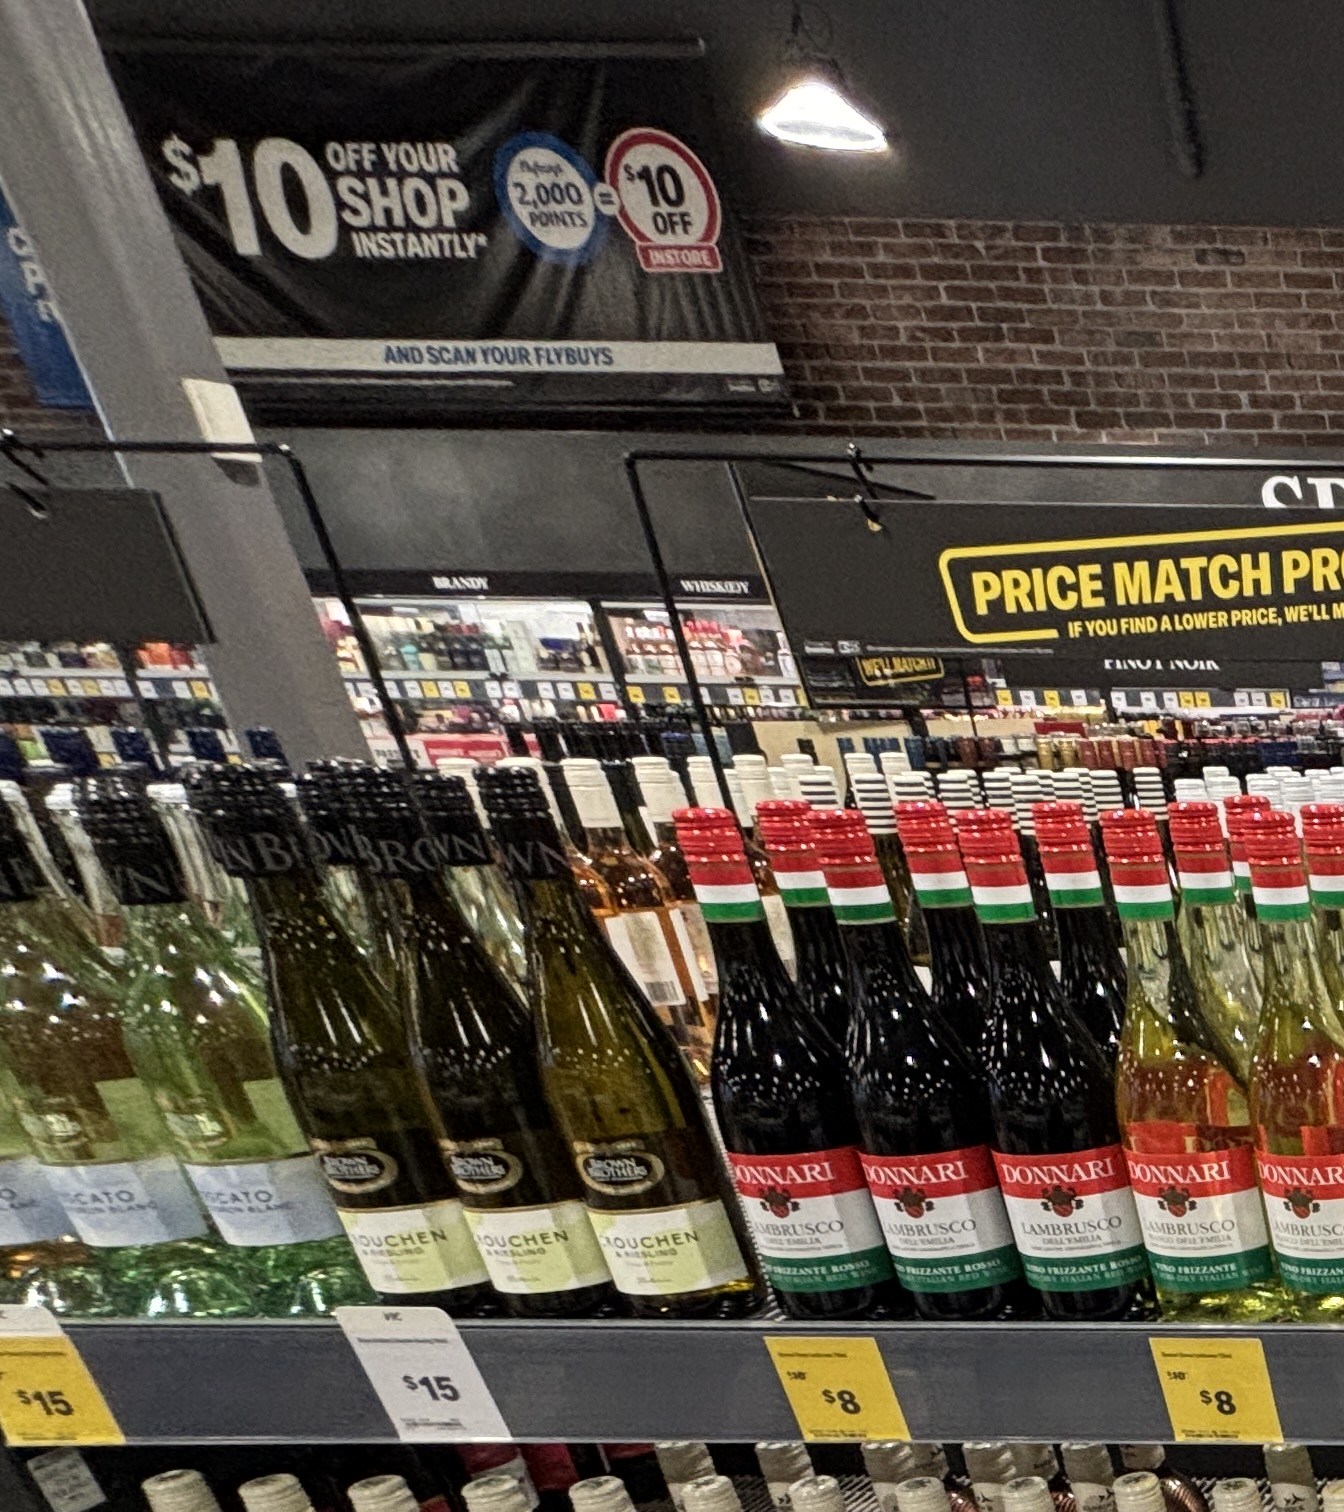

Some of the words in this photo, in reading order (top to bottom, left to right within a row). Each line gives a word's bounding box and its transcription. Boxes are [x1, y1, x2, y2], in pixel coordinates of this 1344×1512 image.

[327, 142, 377, 172] OFF
[383, 142, 460, 175] YOUR
[162, 133, 338, 260] $10
[513, 182, 583, 207] 2,000
[623, 163, 685, 209] $10
[337, 177, 470, 228] SHOP
[528, 211, 588, 229] POINTS
[652, 213, 693, 236] OFF
[648, 248, 712, 268] INSTORE
[384, 345, 424, 366] AND
[426, 345, 478, 366] SCAN
[480, 345, 532, 366] YOUR
[535, 346, 614, 367] FLYBUYS
[433, 576, 489, 591] BRANDY
[971, 564, 1105, 616] PRICE
[1114, 551, 1273, 608] MATCH
[1067, 621, 1083, 638] IF
[1086, 619, 1118, 636] YOU
[1119, 616, 1158, 636] FIND
[1159, 615, 1172, 633] A
[1173, 610, 1228, 631] LOWER
[1230, 607, 1282, 629] PRICE,
[1283, 604, 1329, 623] WE'LL
[1001, 1159, 1116, 1186] DONNARI
[1021, 1215, 1122, 1236] LAMBRUSCO
[402, 1374, 461, 1403] $15
[18, 1389, 74, 1418] $15
[822, 1389, 861, 1416] $8
[1200, 1389, 1236, 1417] $8
